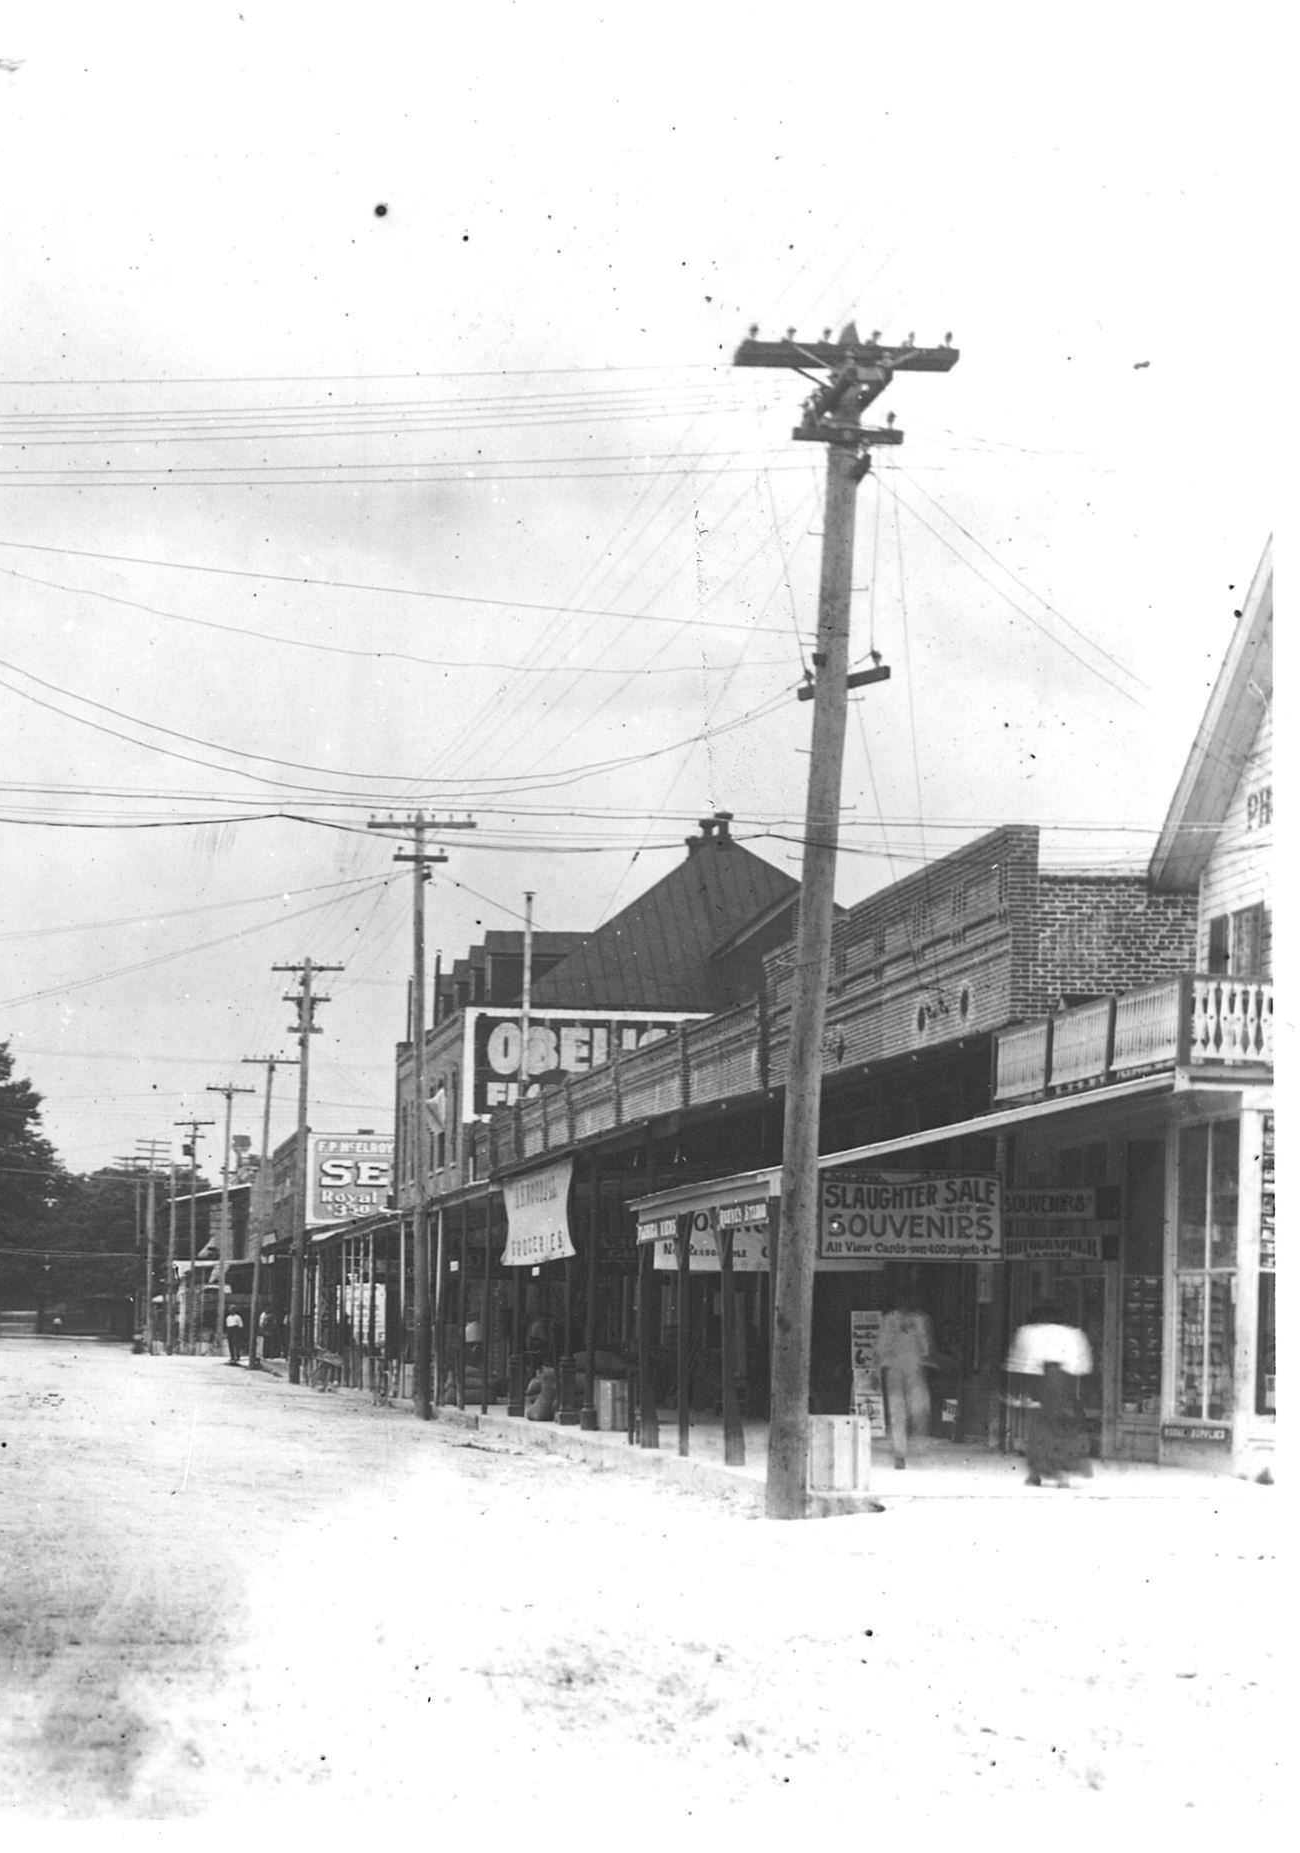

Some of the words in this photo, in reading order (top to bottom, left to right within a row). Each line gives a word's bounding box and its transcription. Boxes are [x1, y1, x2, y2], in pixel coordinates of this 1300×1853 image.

[1247, 785, 1273, 832] PH
[320, 1160, 389, 1188] SE
[321, 1189, 378, 1206] Royal
[824, 1183, 937, 1210] SLAUGHTER
[944, 1179, 997, 1206] SALE
[827, 1213, 993, 1241] SOUVENIRS
[826, 1242, 842, 1253] All
[845, 1241, 872, 1253] View
